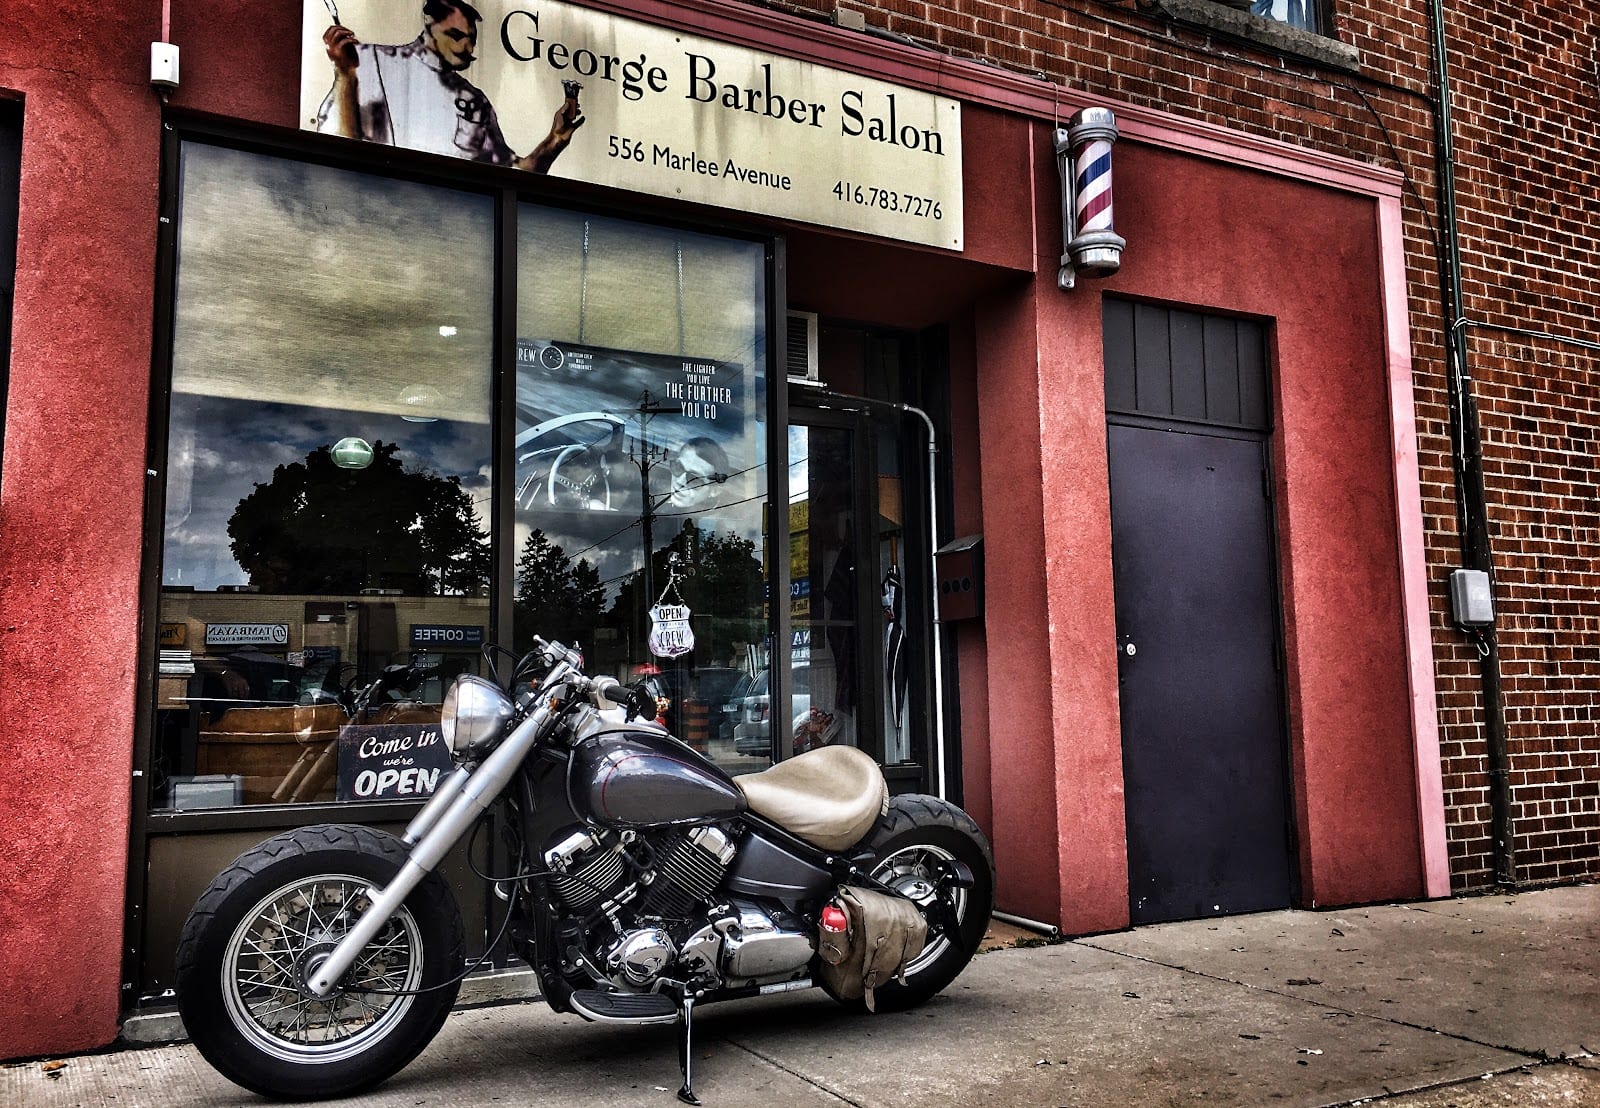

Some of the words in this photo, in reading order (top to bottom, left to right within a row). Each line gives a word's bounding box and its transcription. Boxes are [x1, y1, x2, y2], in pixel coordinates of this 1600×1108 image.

[500, 10, 668, 101] George
[684, 51, 826, 128] Barber
[841, 90, 945, 156] Salon
[608, 135, 645, 162] 556
[653, 144, 719, 177] Marlee
[723, 159, 791, 190] Avenue
[832, 180, 942, 220] 416.783.7276
[682, 362, 692, 373] THE
[693, 364, 716, 375] LIGHTER
[686, 373, 698, 384] YOU
[698, 374, 711, 385] LIVE
[665, 381, 684, 400] THE
[687, 384, 732, 404] FURTHER
[681, 401, 700, 418] YOU
[704, 403, 717, 420] GO
[659, 607, 682, 620] OPEN
[659, 630, 684, 647] CREW
[360, 736, 413, 759] Come
[417, 730, 439, 748] in
[383, 755, 414, 766] we're
[354, 767, 440, 796] OPEN
